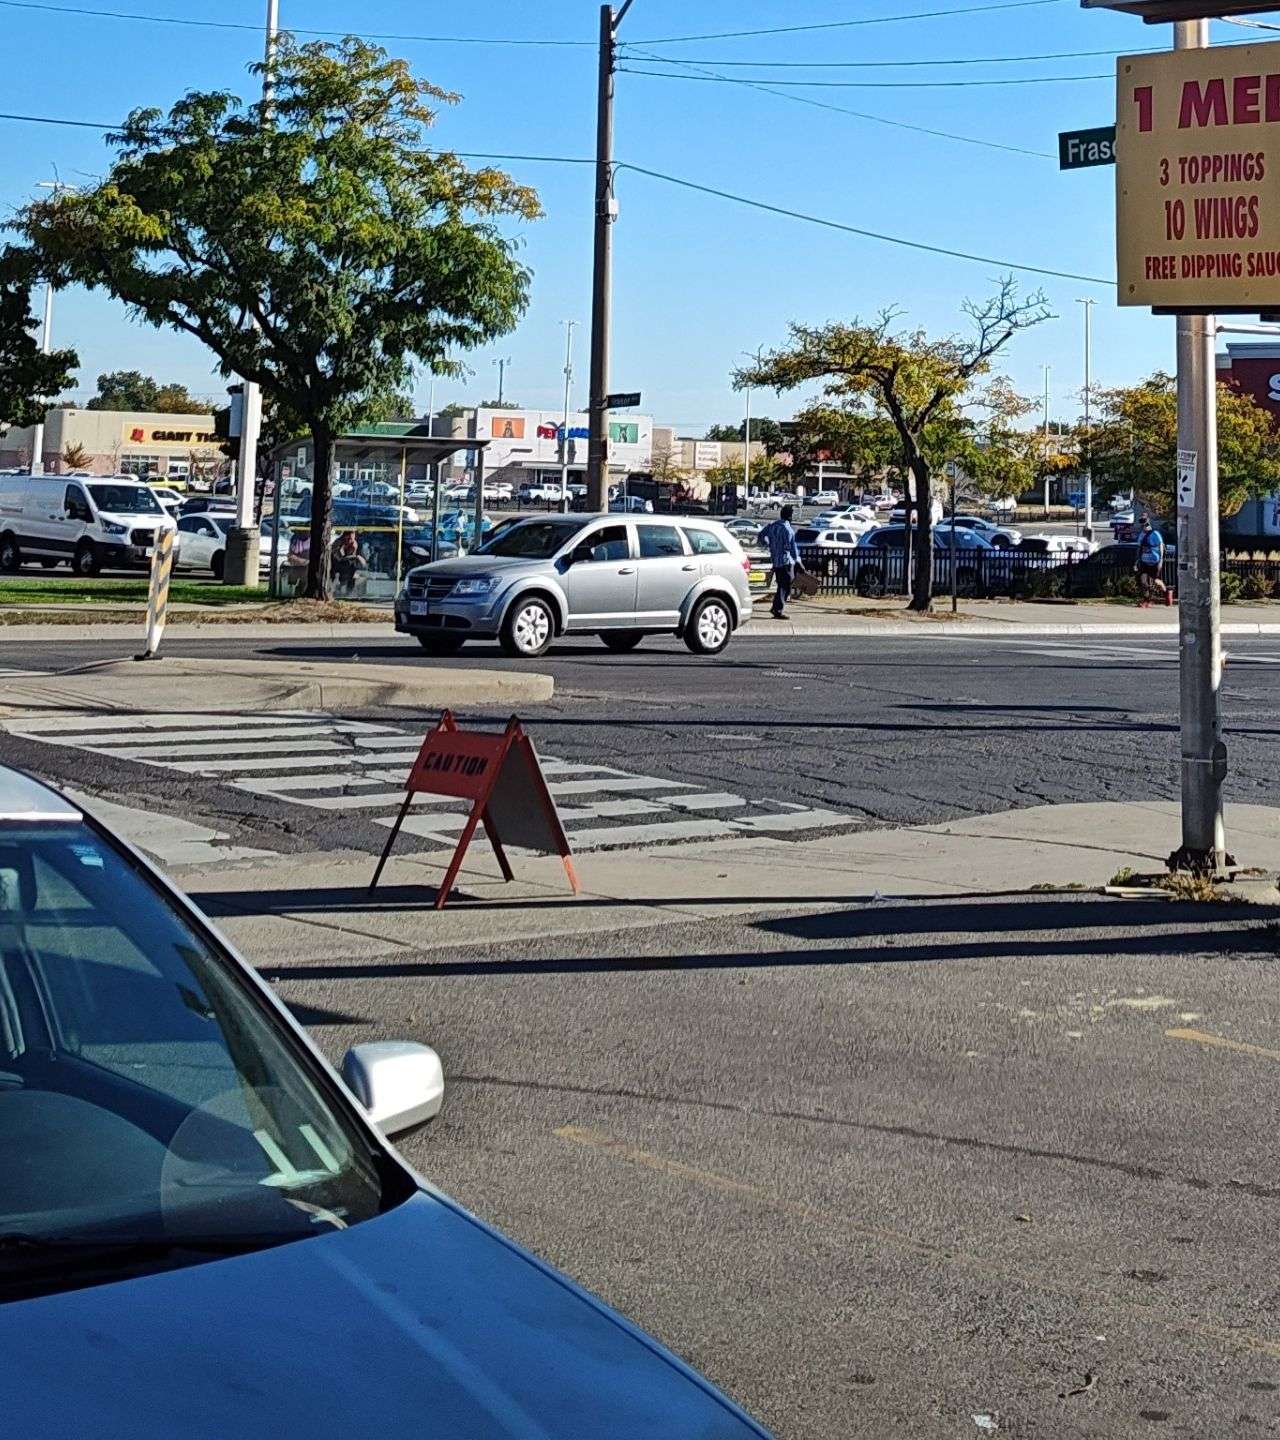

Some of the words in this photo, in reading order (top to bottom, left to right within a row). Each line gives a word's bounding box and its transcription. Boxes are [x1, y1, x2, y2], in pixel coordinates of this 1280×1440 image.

[1134, 86, 1153, 131] 1
[1160, 158, 1170, 186] 3
[1178, 152, 1265, 184] TOPPINGS
[1165, 199, 1186, 240] 10
[1194, 195, 1259, 239] WINGS
[1145, 255, 1176, 279] FREE
[1181, 253, 1242, 278] DIPPING
[152, 431, 193, 442] GIANT
[423, 751, 489, 776] CAUTION
